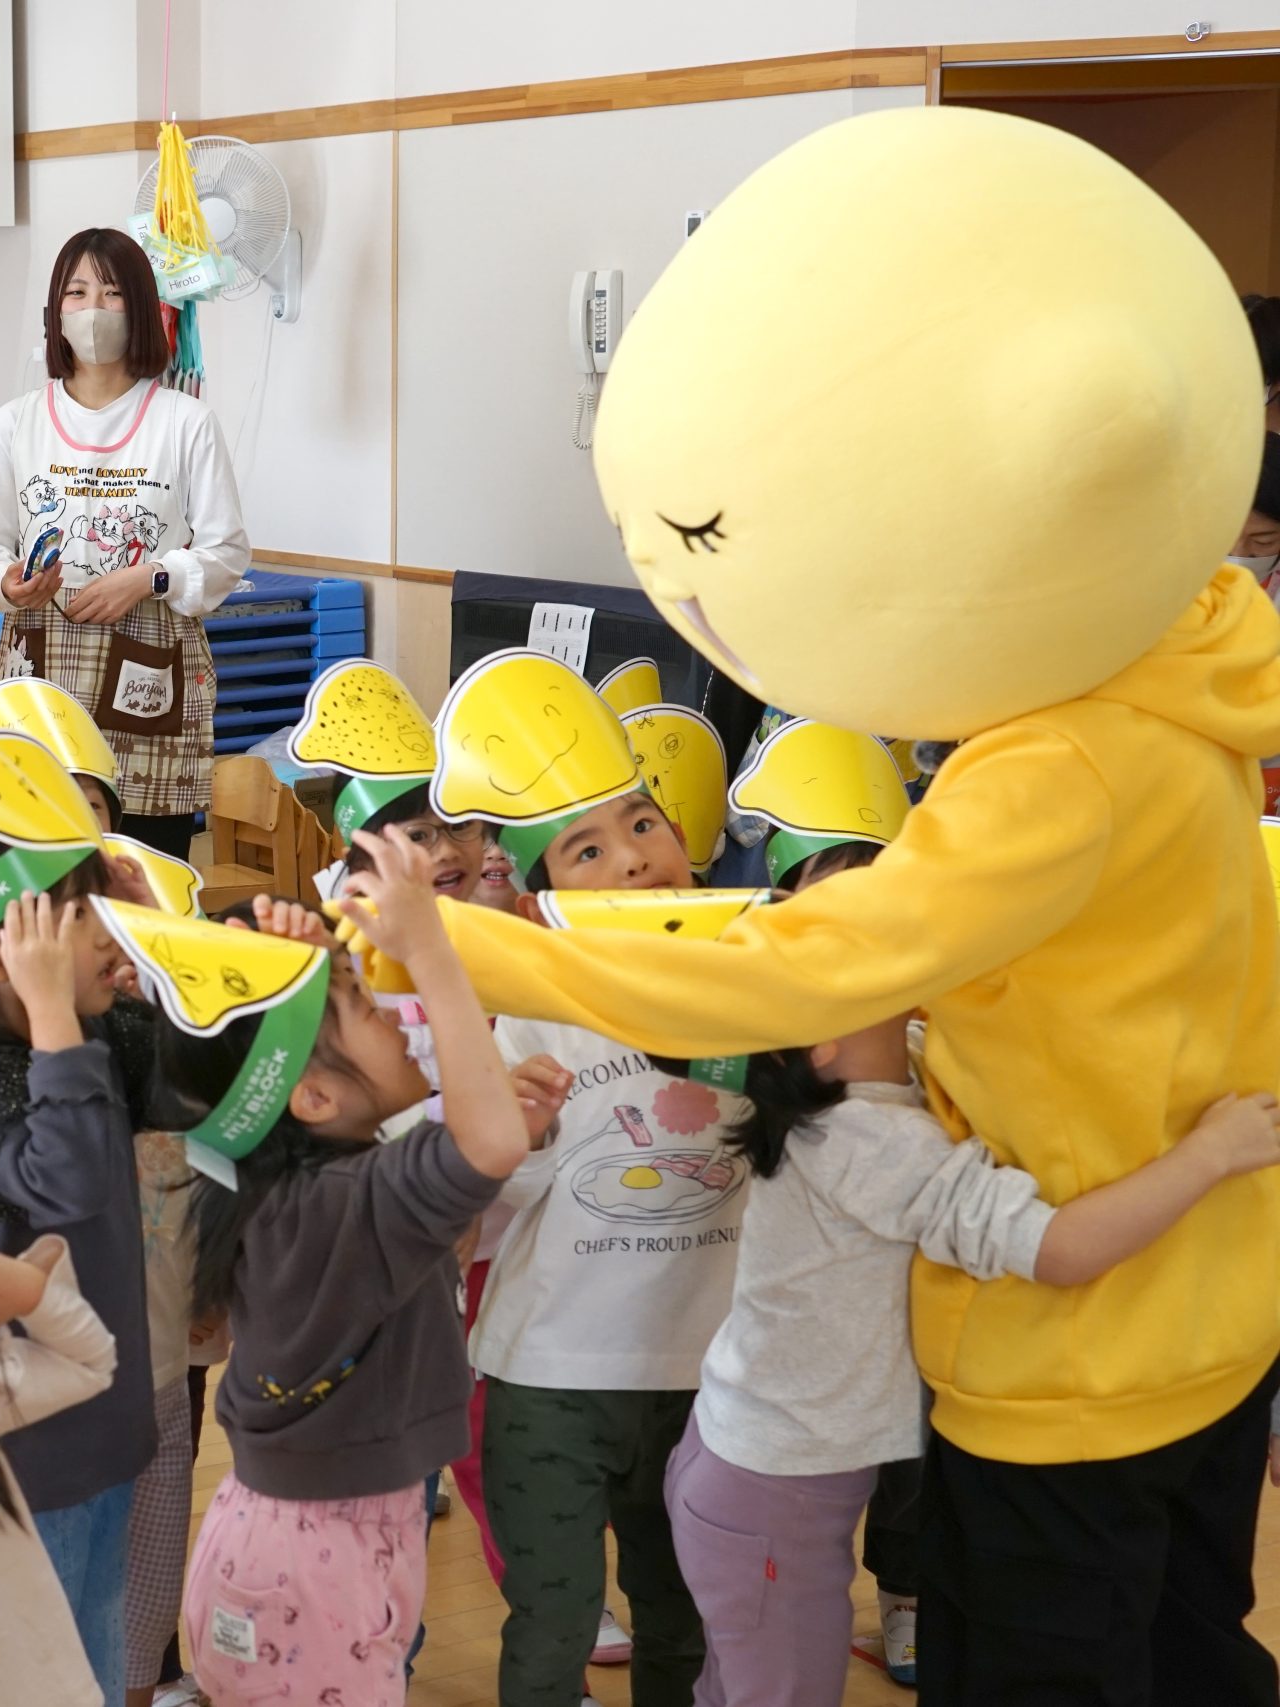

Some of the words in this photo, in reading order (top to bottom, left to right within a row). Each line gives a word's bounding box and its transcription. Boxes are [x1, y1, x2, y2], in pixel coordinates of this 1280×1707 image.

[168, 274, 200, 290] Hiroto
[96, 467, 147, 478] LOYALTY
[137, 479, 161, 488] them
[92, 487, 138, 498] FAMILY.
[245, 1048, 289, 1113] BLOCK
[574, 1237, 631, 1255] CHEF'S
[636, 1236, 692, 1252] PROUD
[696, 1227, 739, 1248] MENU
